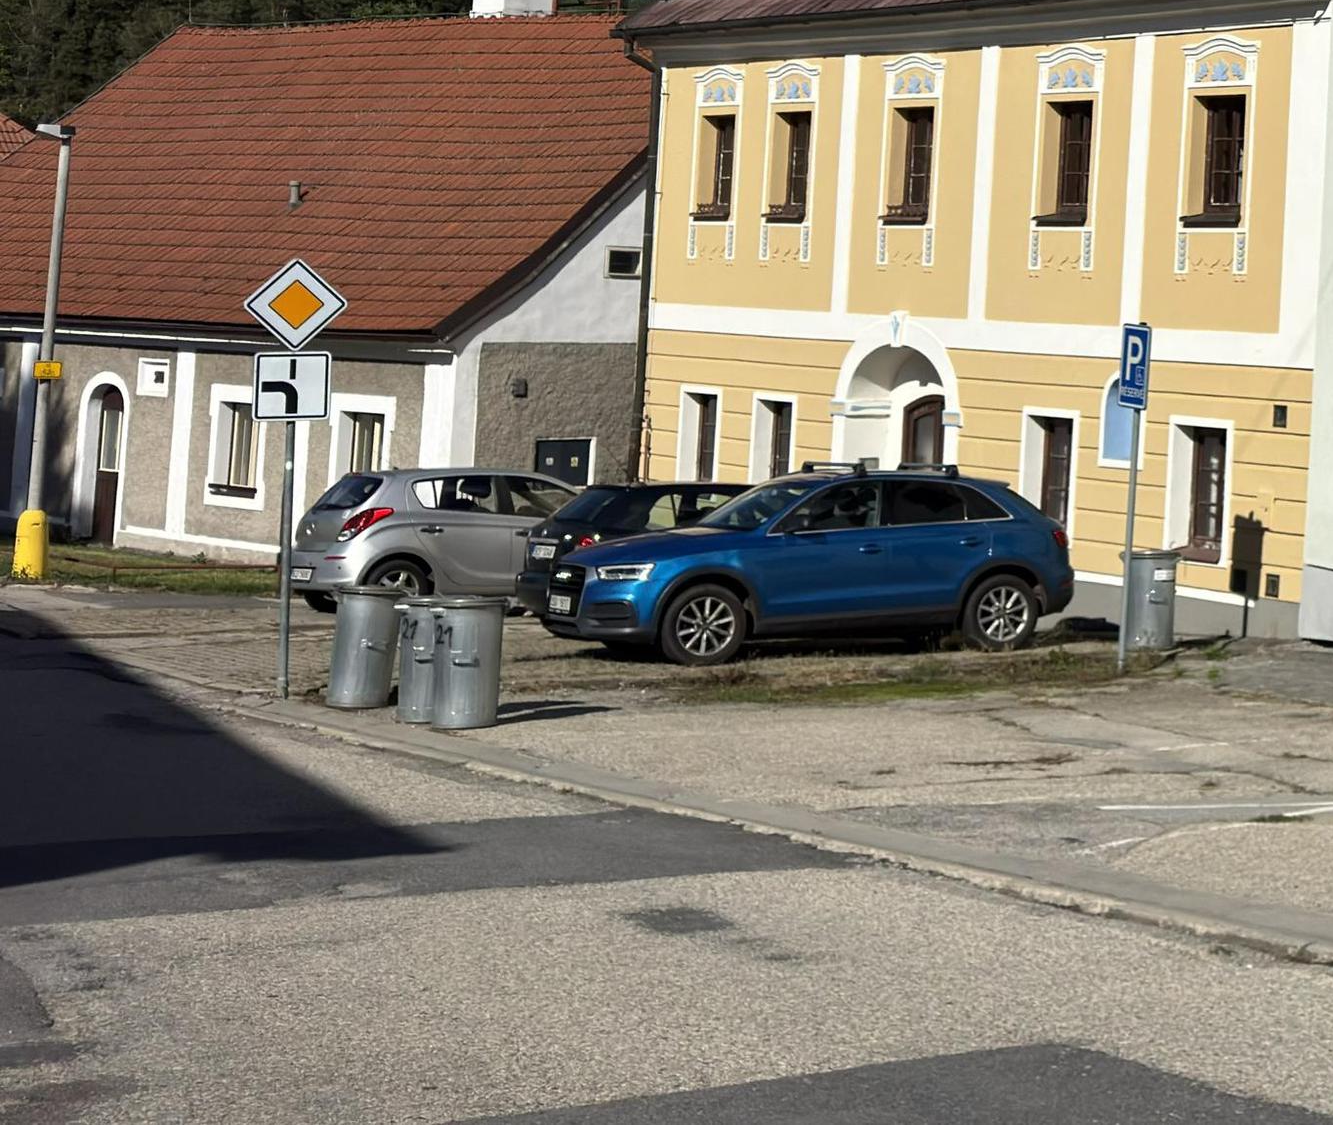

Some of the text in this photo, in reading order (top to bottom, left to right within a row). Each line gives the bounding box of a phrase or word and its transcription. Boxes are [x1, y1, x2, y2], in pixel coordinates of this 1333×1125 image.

[1125, 334, 1144, 381] P
[402, 618, 419, 640] 21
[435, 624, 454, 649] 21
